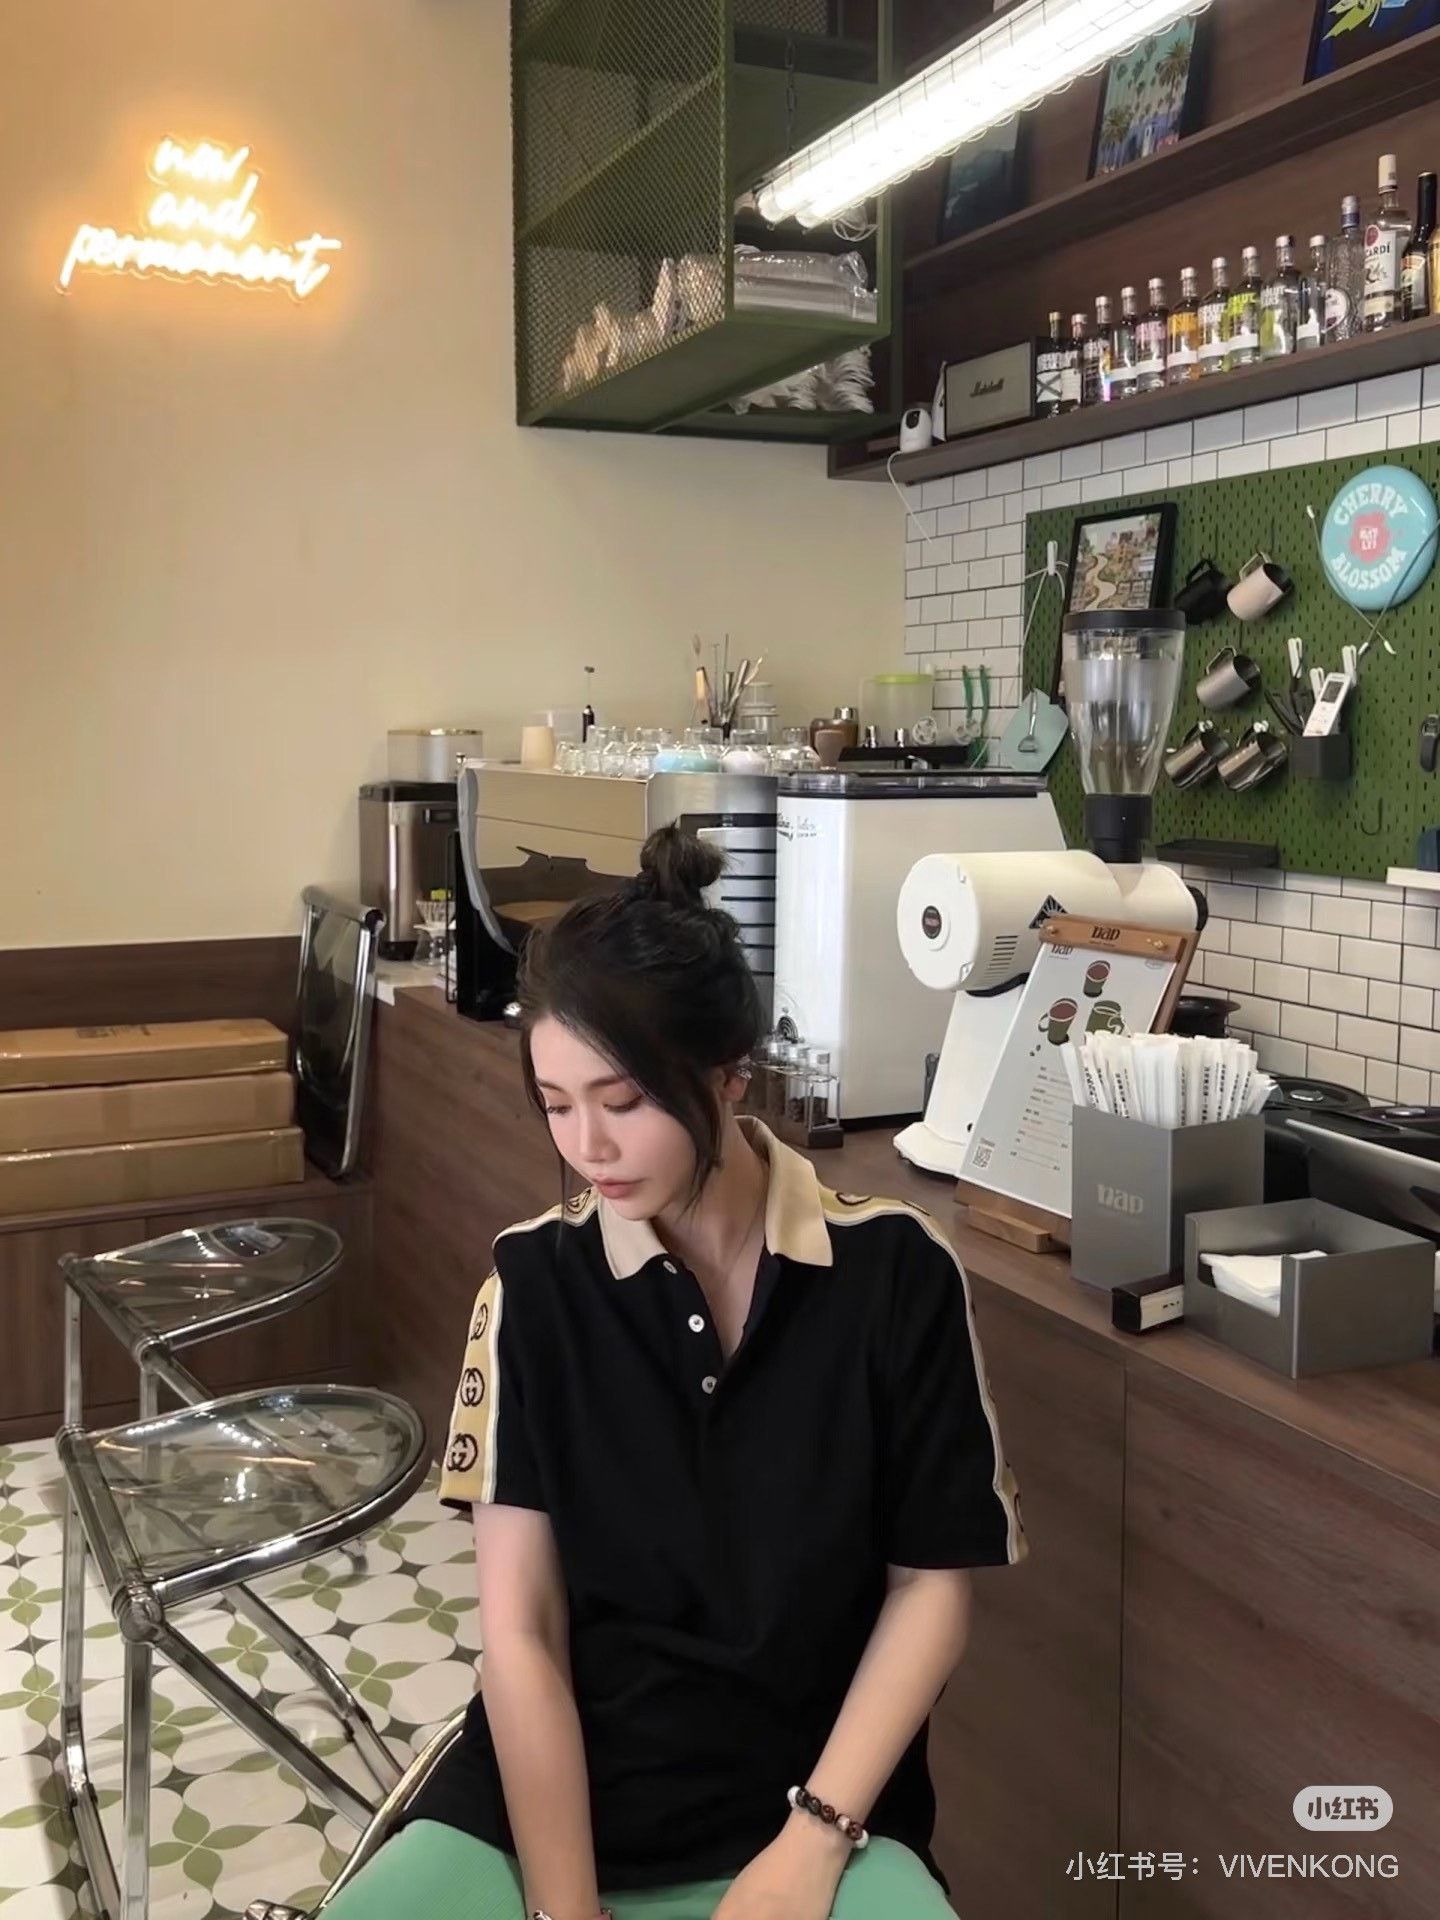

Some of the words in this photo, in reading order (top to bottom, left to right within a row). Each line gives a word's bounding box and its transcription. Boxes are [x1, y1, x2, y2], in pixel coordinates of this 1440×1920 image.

[148, 173, 258, 240] and
[1333, 482, 1408, 525] CHERRY
[1330, 546, 1407, 591] BLOSSOM
